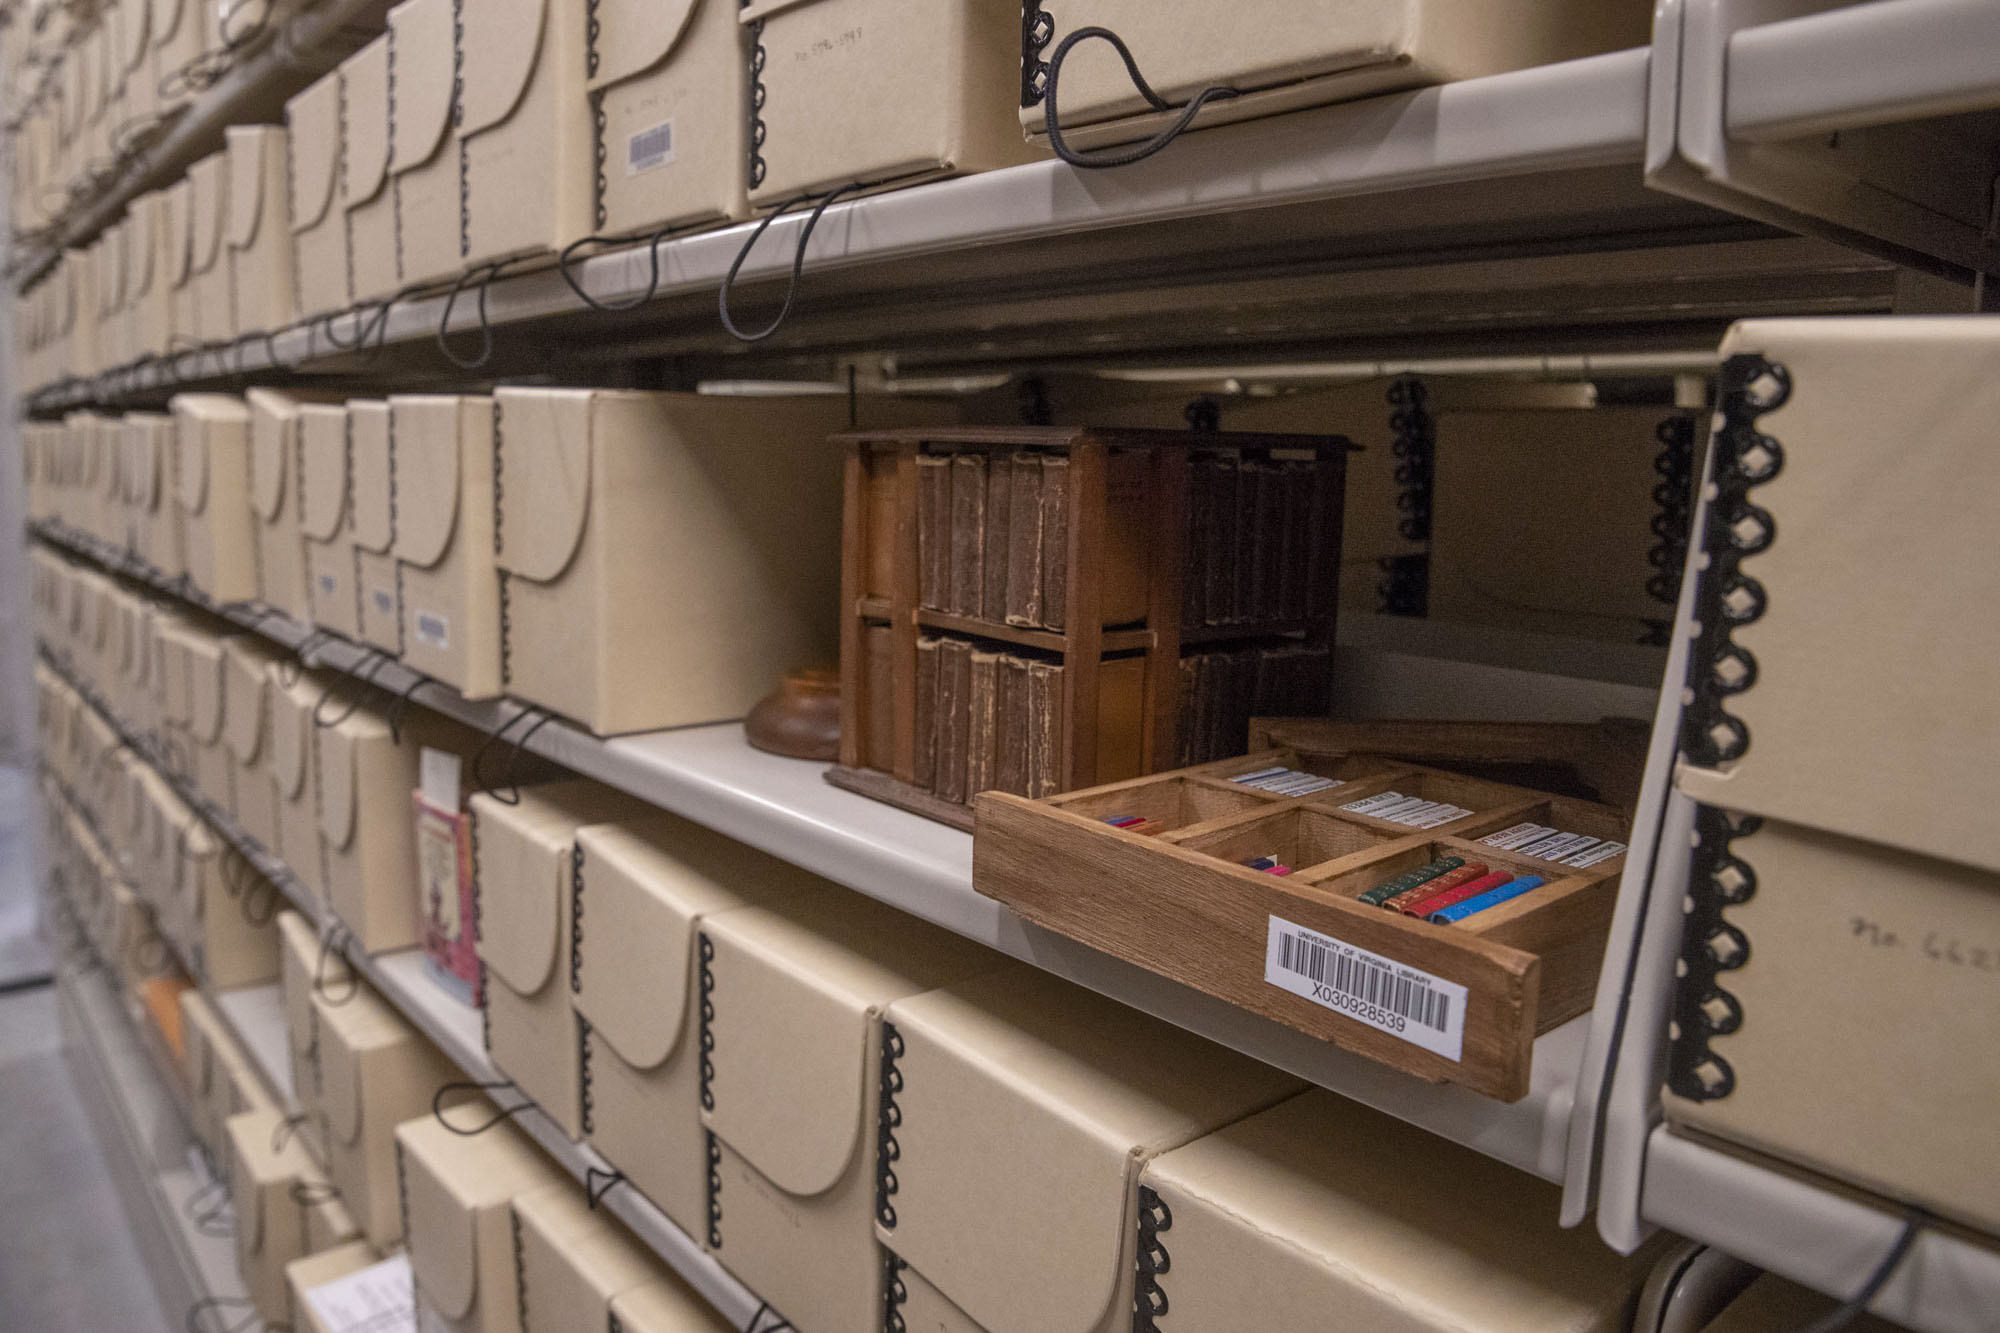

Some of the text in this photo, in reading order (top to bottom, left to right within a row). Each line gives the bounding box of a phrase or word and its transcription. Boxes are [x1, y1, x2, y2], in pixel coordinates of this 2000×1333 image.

[1298, 930, 1432, 986] UNIVERSITY OF VIRGINIA LIBRARY
[1312, 982, 1406, 1032] X030928539
